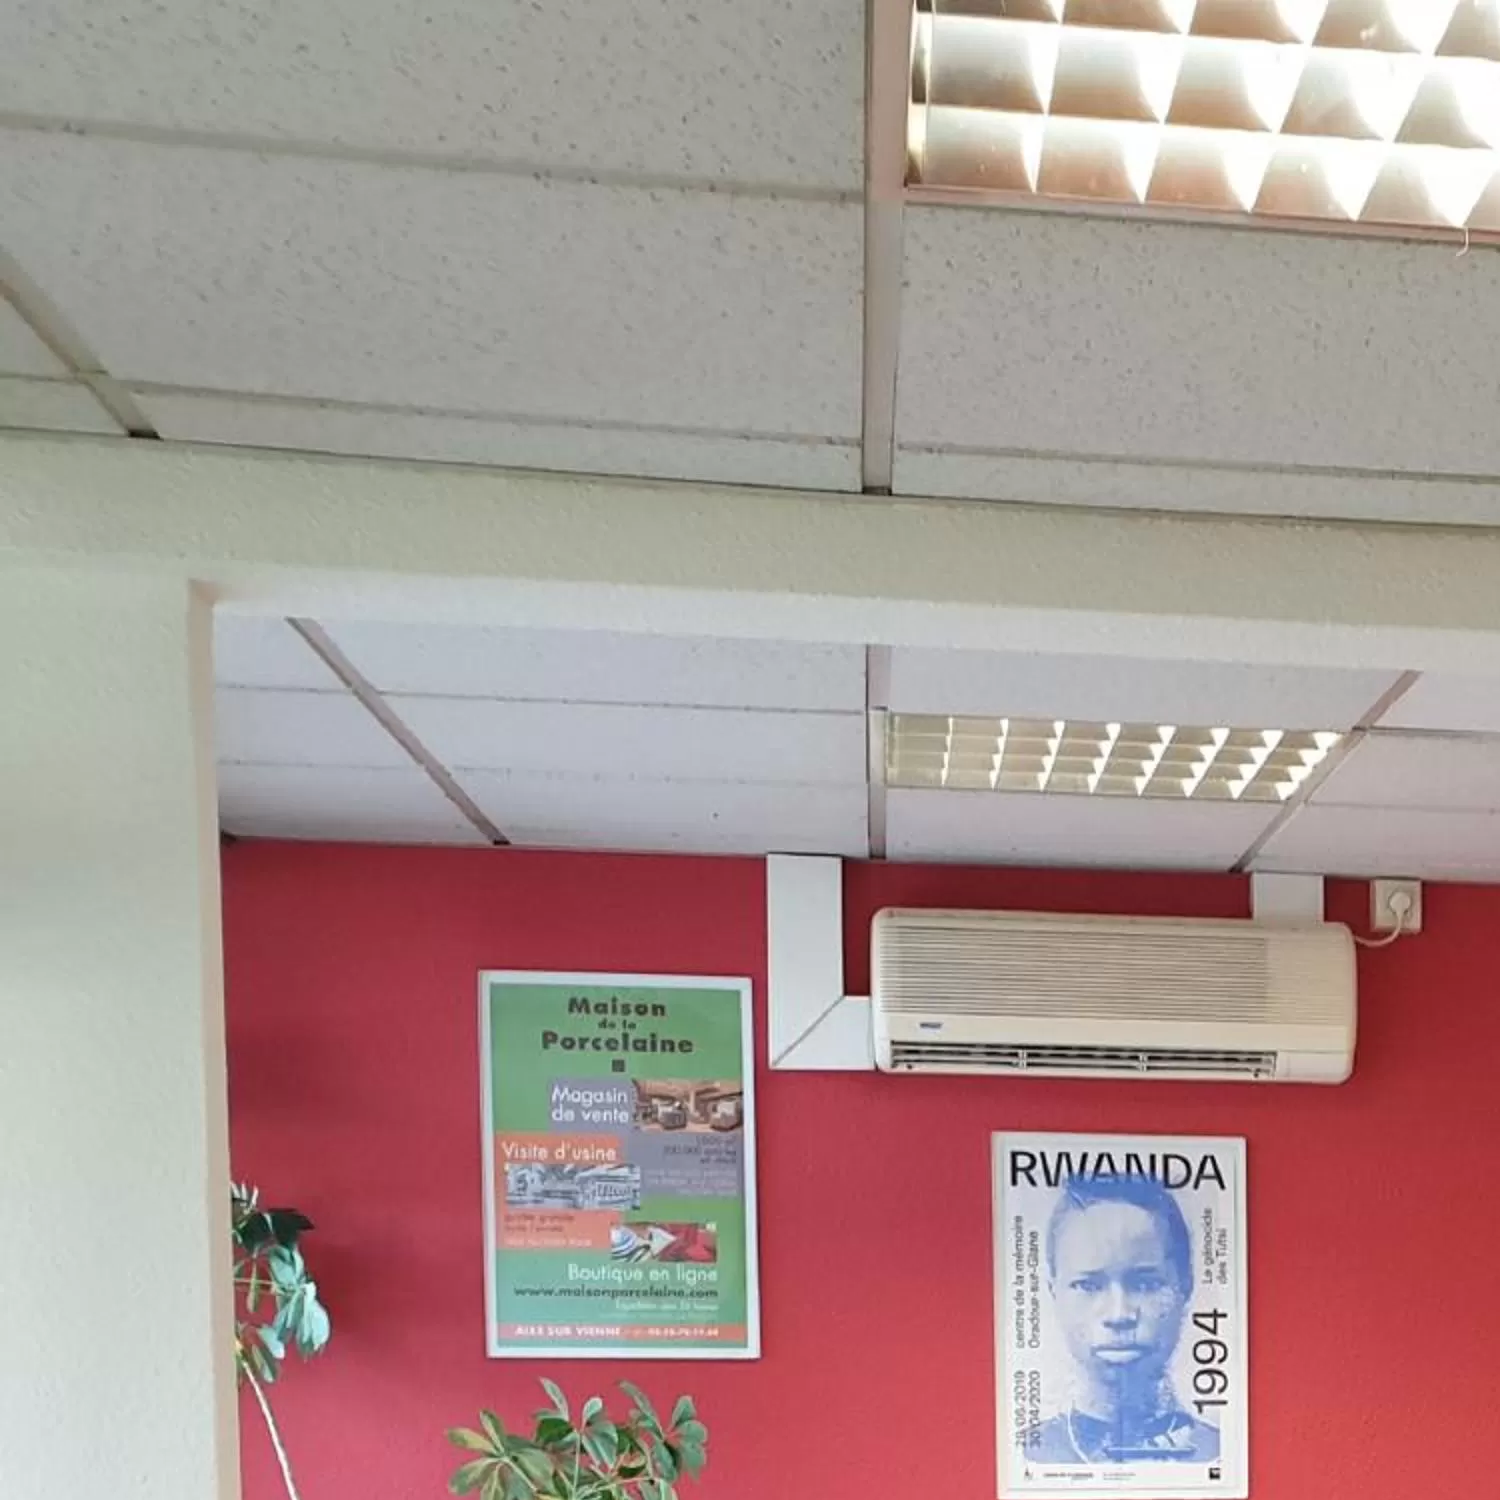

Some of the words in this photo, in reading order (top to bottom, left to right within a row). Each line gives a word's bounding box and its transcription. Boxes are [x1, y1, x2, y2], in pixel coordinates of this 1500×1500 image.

[568, 996, 666, 1017] Maison
[598, 1018, 616, 1029] de
[622, 1019, 637, 1030] la
[542, 1029, 694, 1053] Porcelaine
[551, 1084, 629, 1108] Magasin
[551, 1103, 576, 1122] de
[581, 1107, 630, 1124] vente
[501, 1140, 549, 1160] Visite
[555, 1140, 617, 1161] d'usine
[1009, 1150, 1227, 1191] RWANDA
[567, 1263, 644, 1285] Boutique
[649, 1268, 670, 1281] en
[676, 1264, 718, 1287] ligne
[514, 1284, 719, 1299] www.maisonporcelaine.com
[1192, 1309, 1228, 1414] 1994
